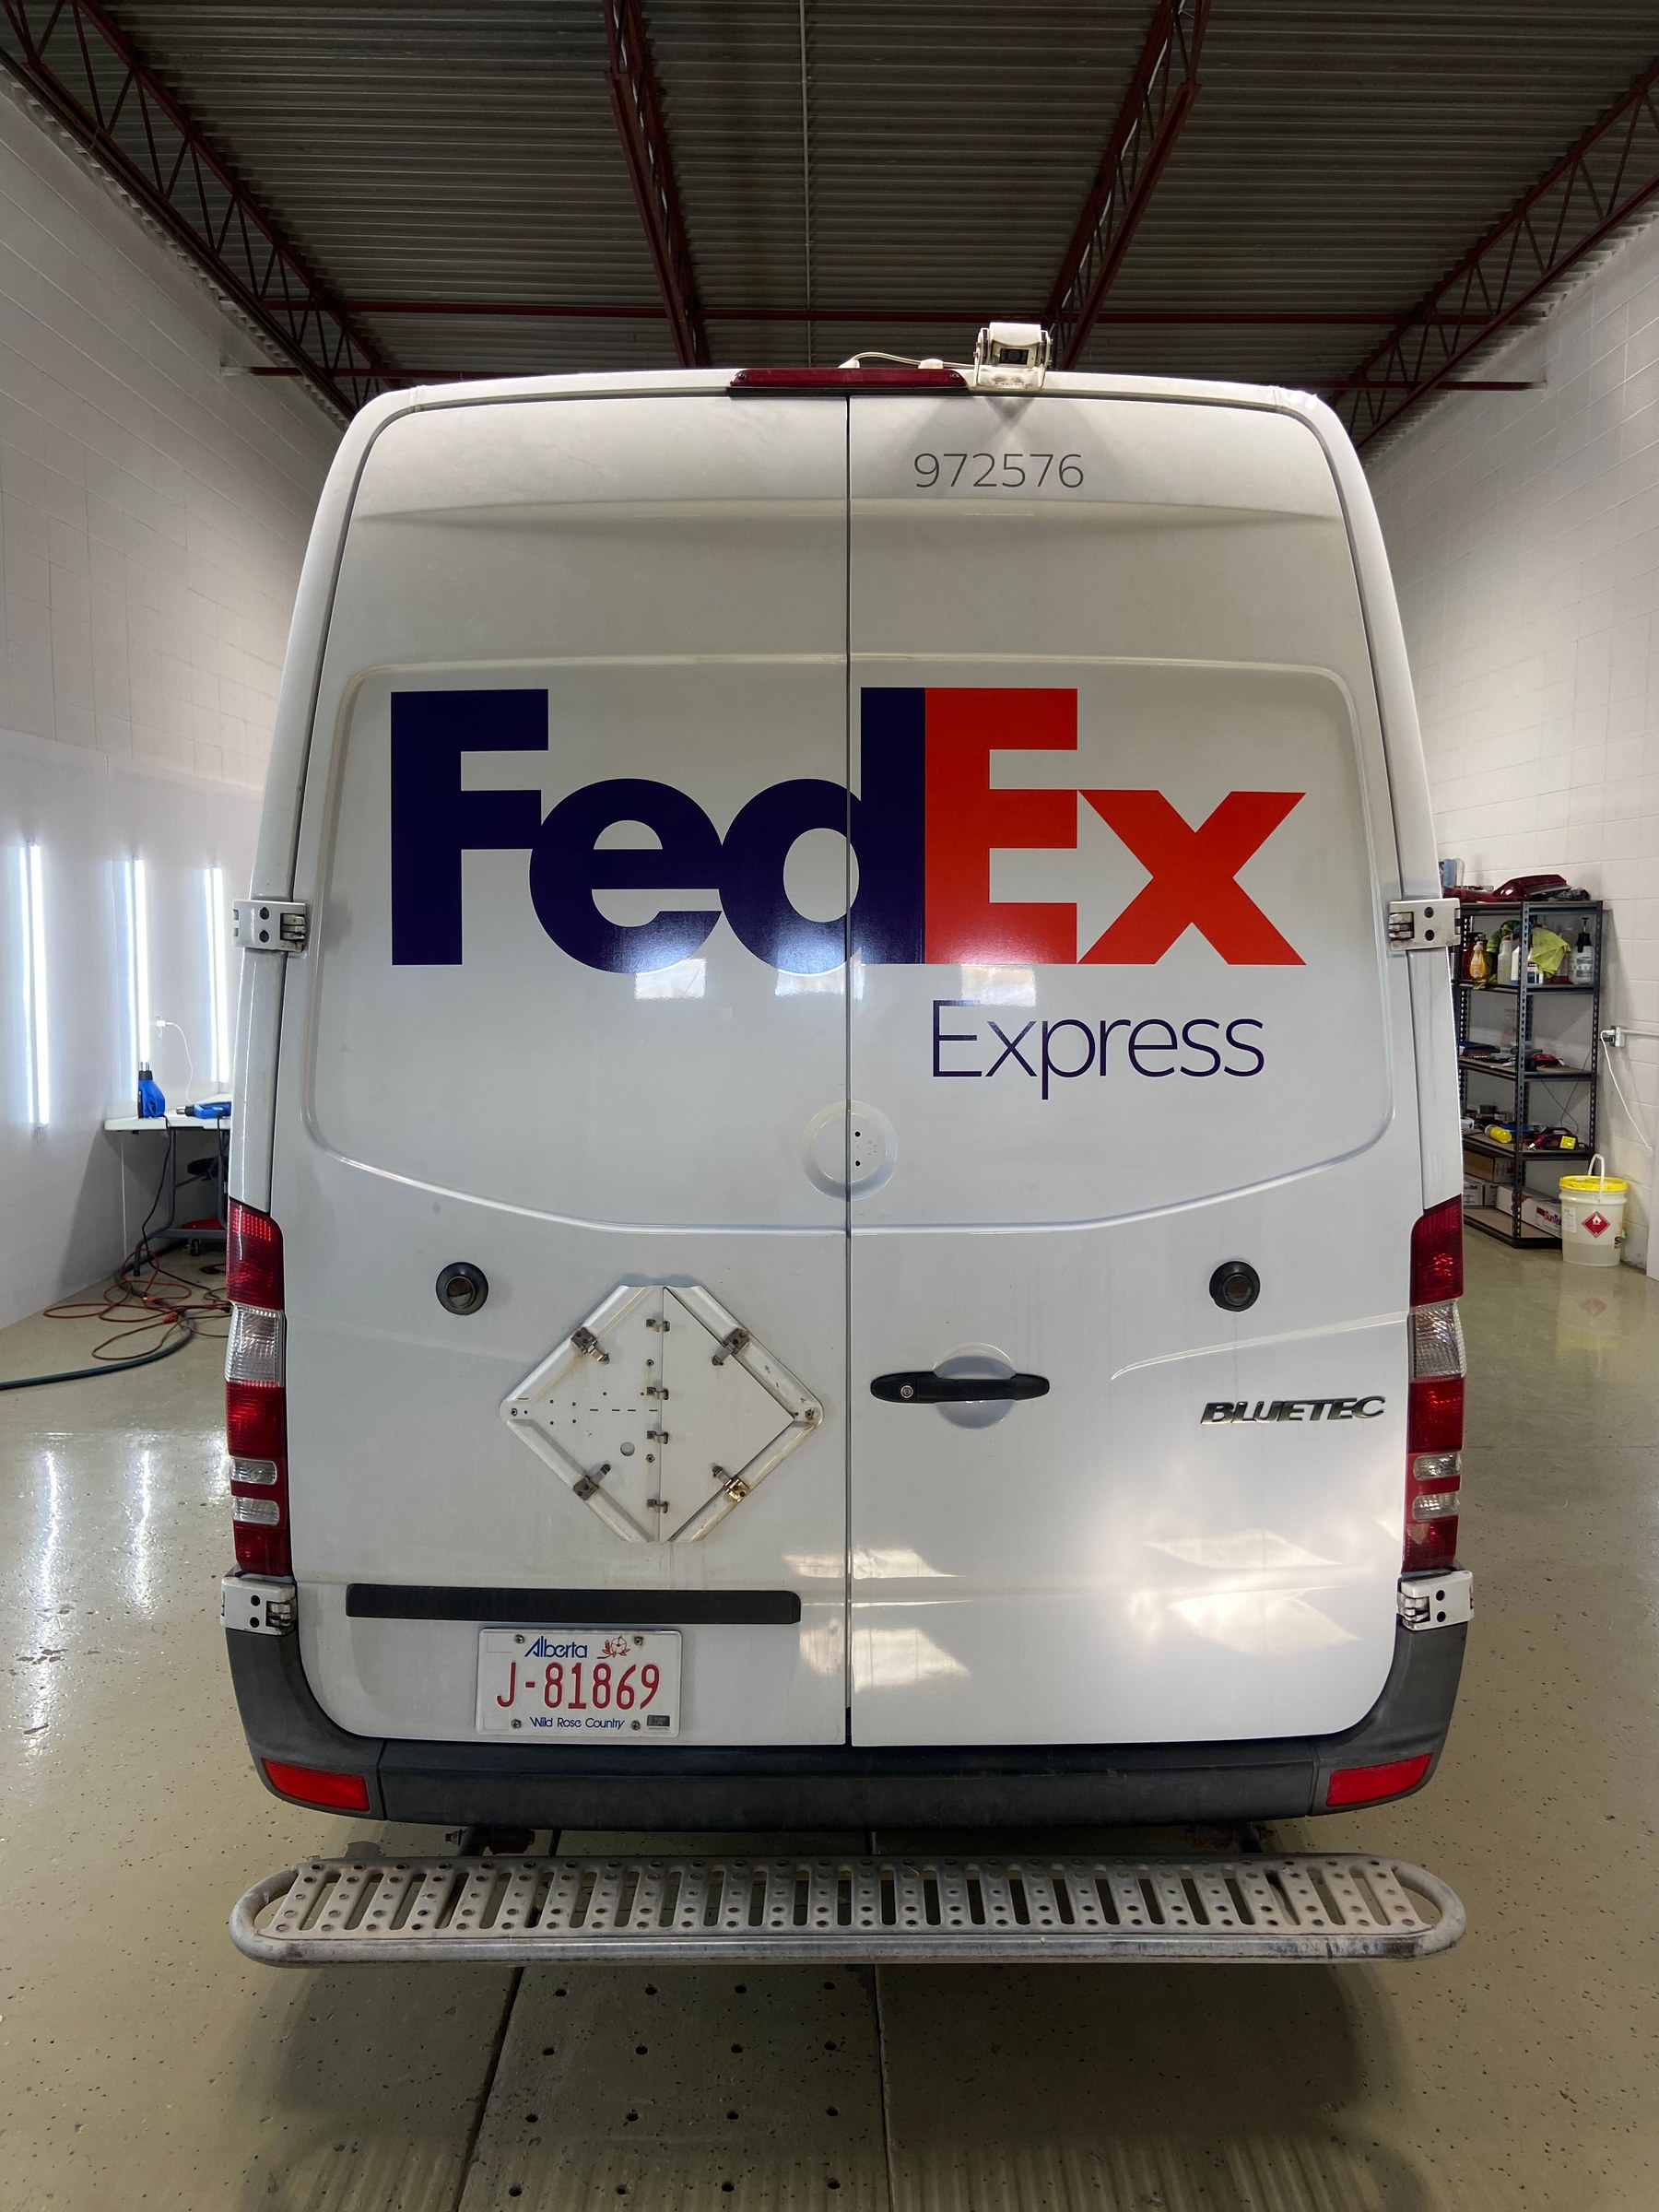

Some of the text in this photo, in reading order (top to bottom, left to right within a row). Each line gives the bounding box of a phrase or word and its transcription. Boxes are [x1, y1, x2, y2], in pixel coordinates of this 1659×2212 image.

[913, 453, 1085, 489] 972576
[391, 687, 1307, 973] FedEx
[932, 998, 1265, 1100] Express
[1200, 1395, 1386, 1425] BLUETEC
[524, 1636, 588, 1658] Alberta
[496, 1662, 660, 1711] J-81869
[529, 1716, 626, 1730] Wild Rose Country
